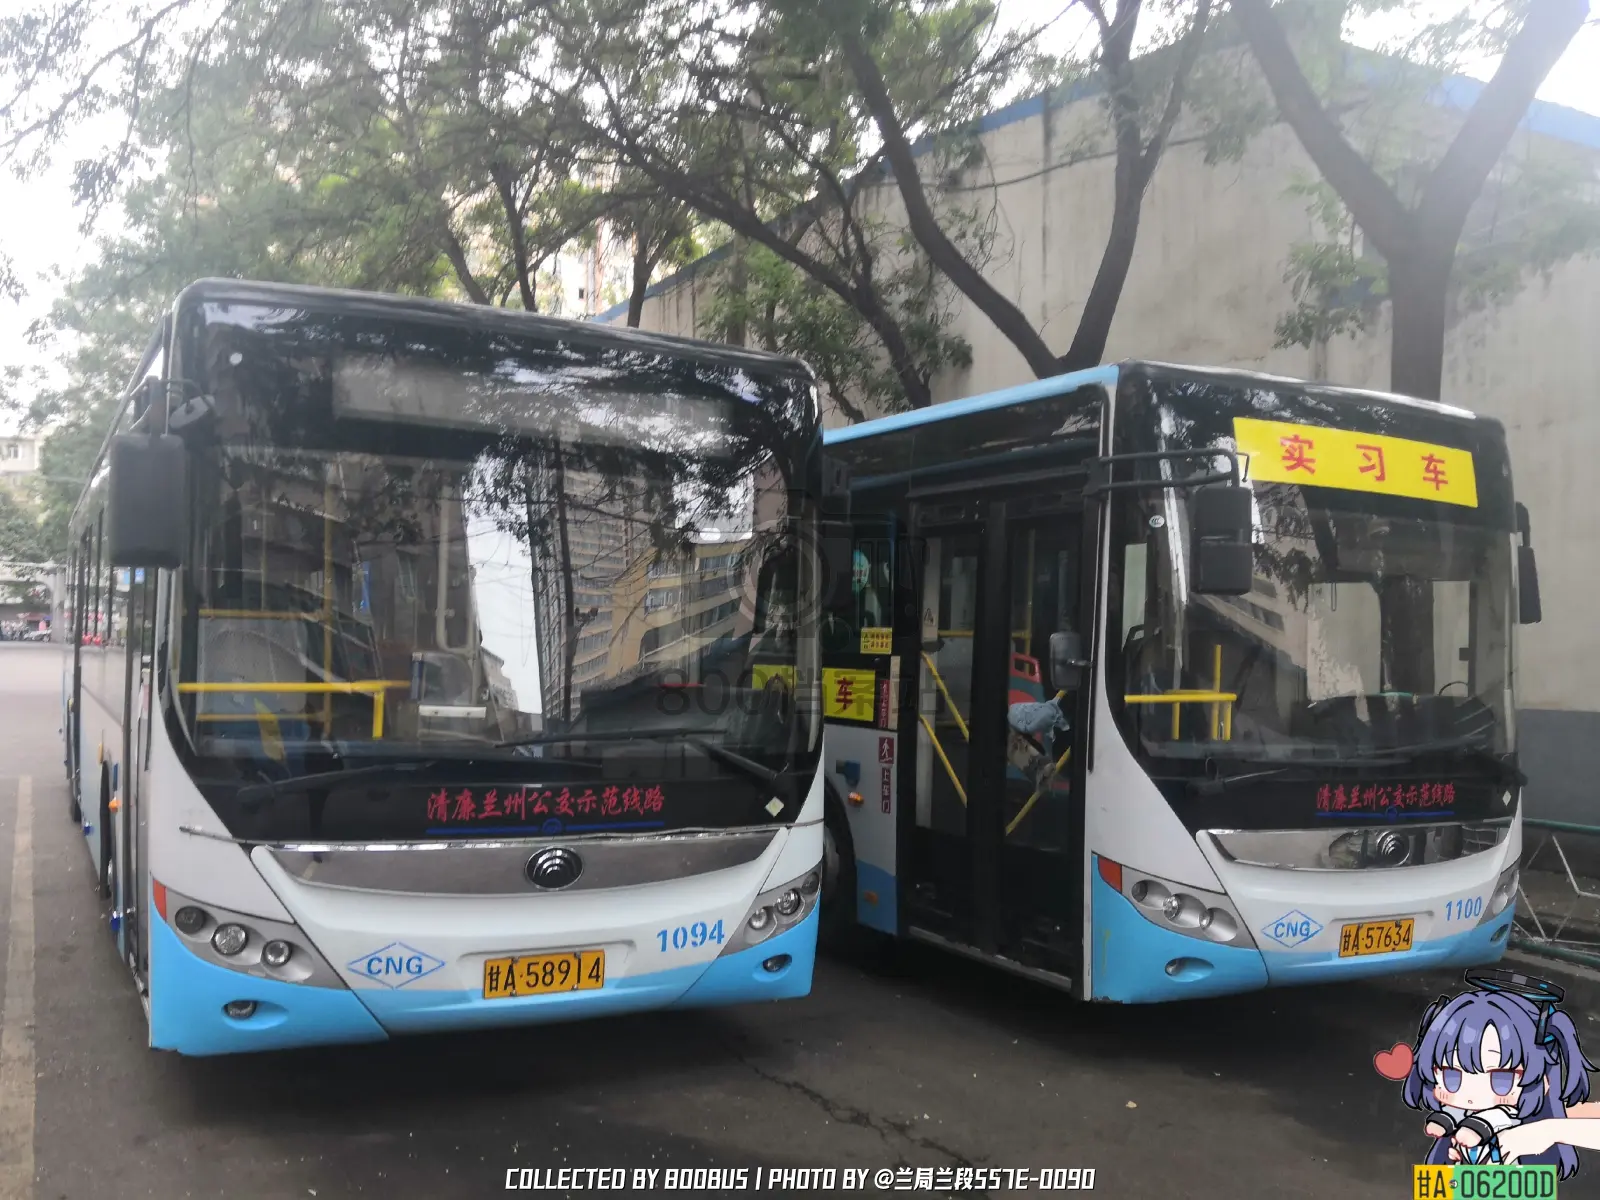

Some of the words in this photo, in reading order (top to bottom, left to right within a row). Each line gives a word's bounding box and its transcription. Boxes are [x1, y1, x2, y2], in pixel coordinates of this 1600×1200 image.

[1280, 434, 1448, 490] 实习车
[835, 676, 854, 710] 车
[427, 784, 665, 822] 清廉兰州公交示范线路
[1316, 782, 1456, 811] 清廉兰州公交示范线路
[1445, 896, 1483, 921] 1100
[656, 919, 725, 952] 1094
[1274, 920, 1311, 938] CNG
[366, 955, 424, 976] CNG
